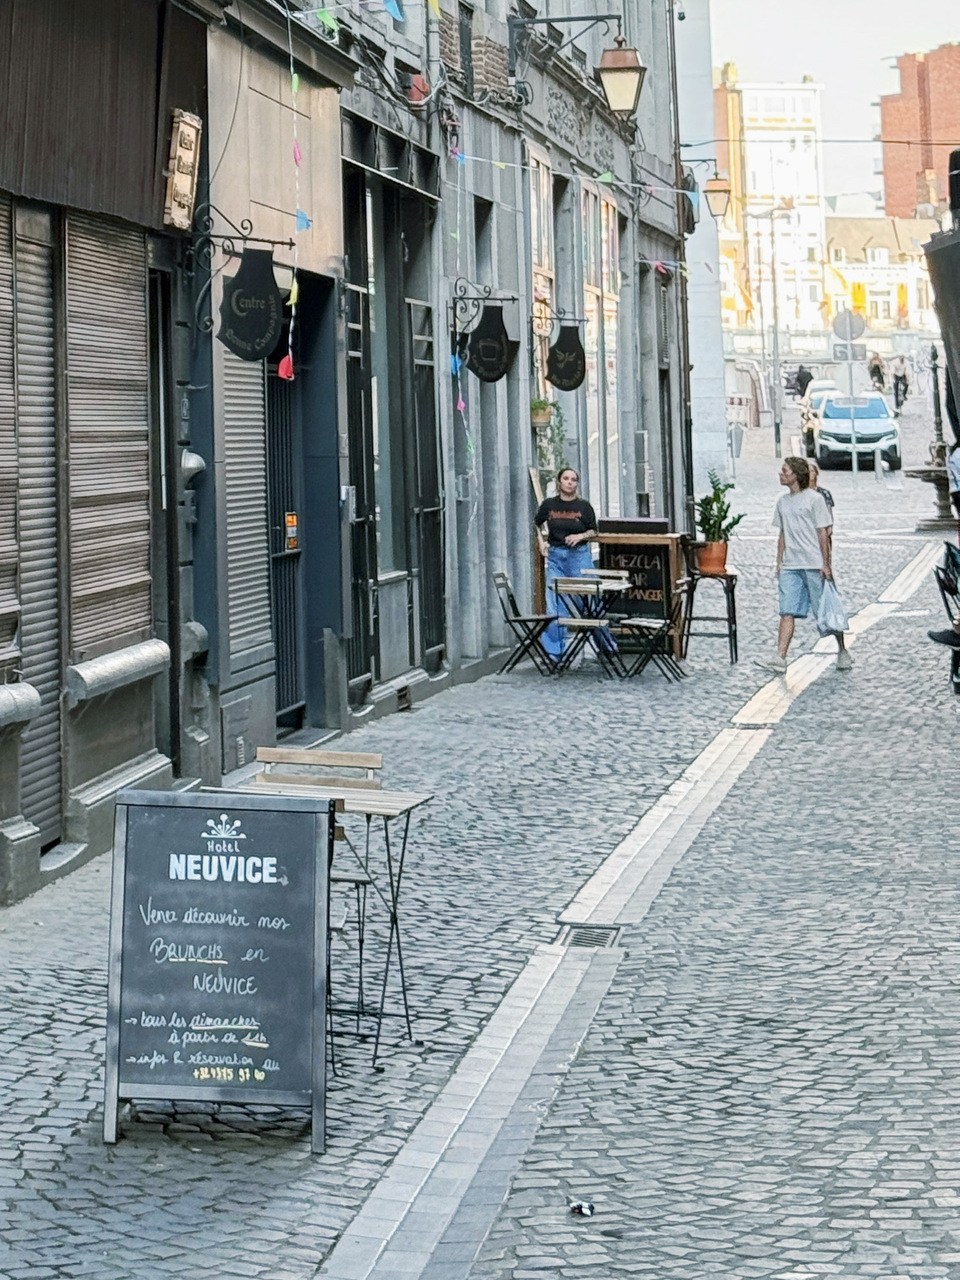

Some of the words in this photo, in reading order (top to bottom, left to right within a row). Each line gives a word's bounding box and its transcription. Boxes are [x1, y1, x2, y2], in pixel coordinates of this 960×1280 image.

[231, 288, 265, 317] Centre
[610, 554, 661, 570] MEZCLA
[207, 840, 240, 853] Hotel
[169, 854, 278, 883] NEUVICE
[139, 897, 178, 926] Venez
[183, 907, 250, 927] découvrir
[257, 916, 290, 930] nos
[150, 937, 224, 963] BRUNCHS
[241, 947, 270, 962] en
[193, 969, 258, 994] NEUVICE
[140, 1011, 167, 1028] tous
[168, 1012, 187, 1028] les
[190, 1013, 261, 1028] dimanches
[168, 1031, 180, 1044] à
[182, 1032, 218, 1048] partir
[221, 1033, 239, 1044] de
[137, 1051, 168, 1069] infos
[188, 1051, 254, 1065] réservation
[262, 1060, 280, 1070] au
